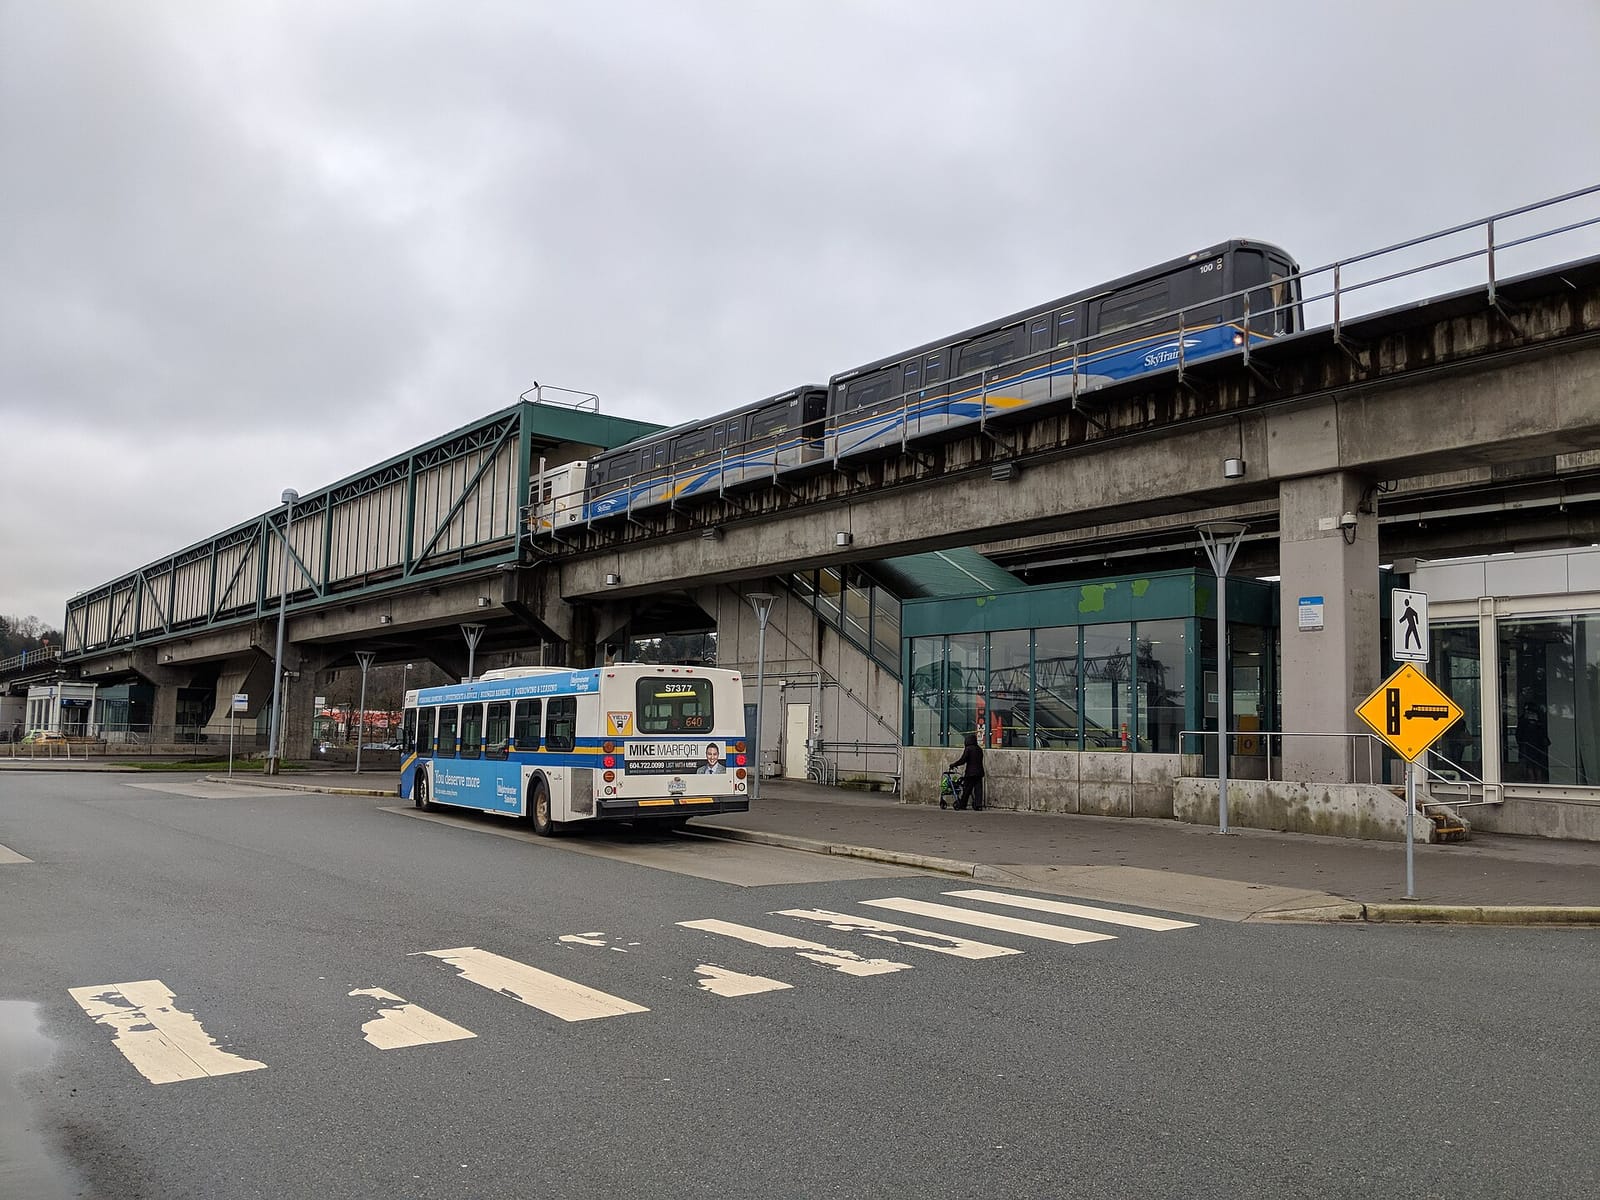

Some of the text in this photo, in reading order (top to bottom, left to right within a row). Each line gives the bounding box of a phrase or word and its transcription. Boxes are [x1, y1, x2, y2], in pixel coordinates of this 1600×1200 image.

[1200, 263, 1213, 274] 100
[665, 684, 693, 693] S7377
[685, 717, 703, 728] 640
[629, 743, 699, 758] MIKE MARFORI
[629, 761, 665, 769] 604.722.0099
[434, 769, 480, 788] You deserve more
